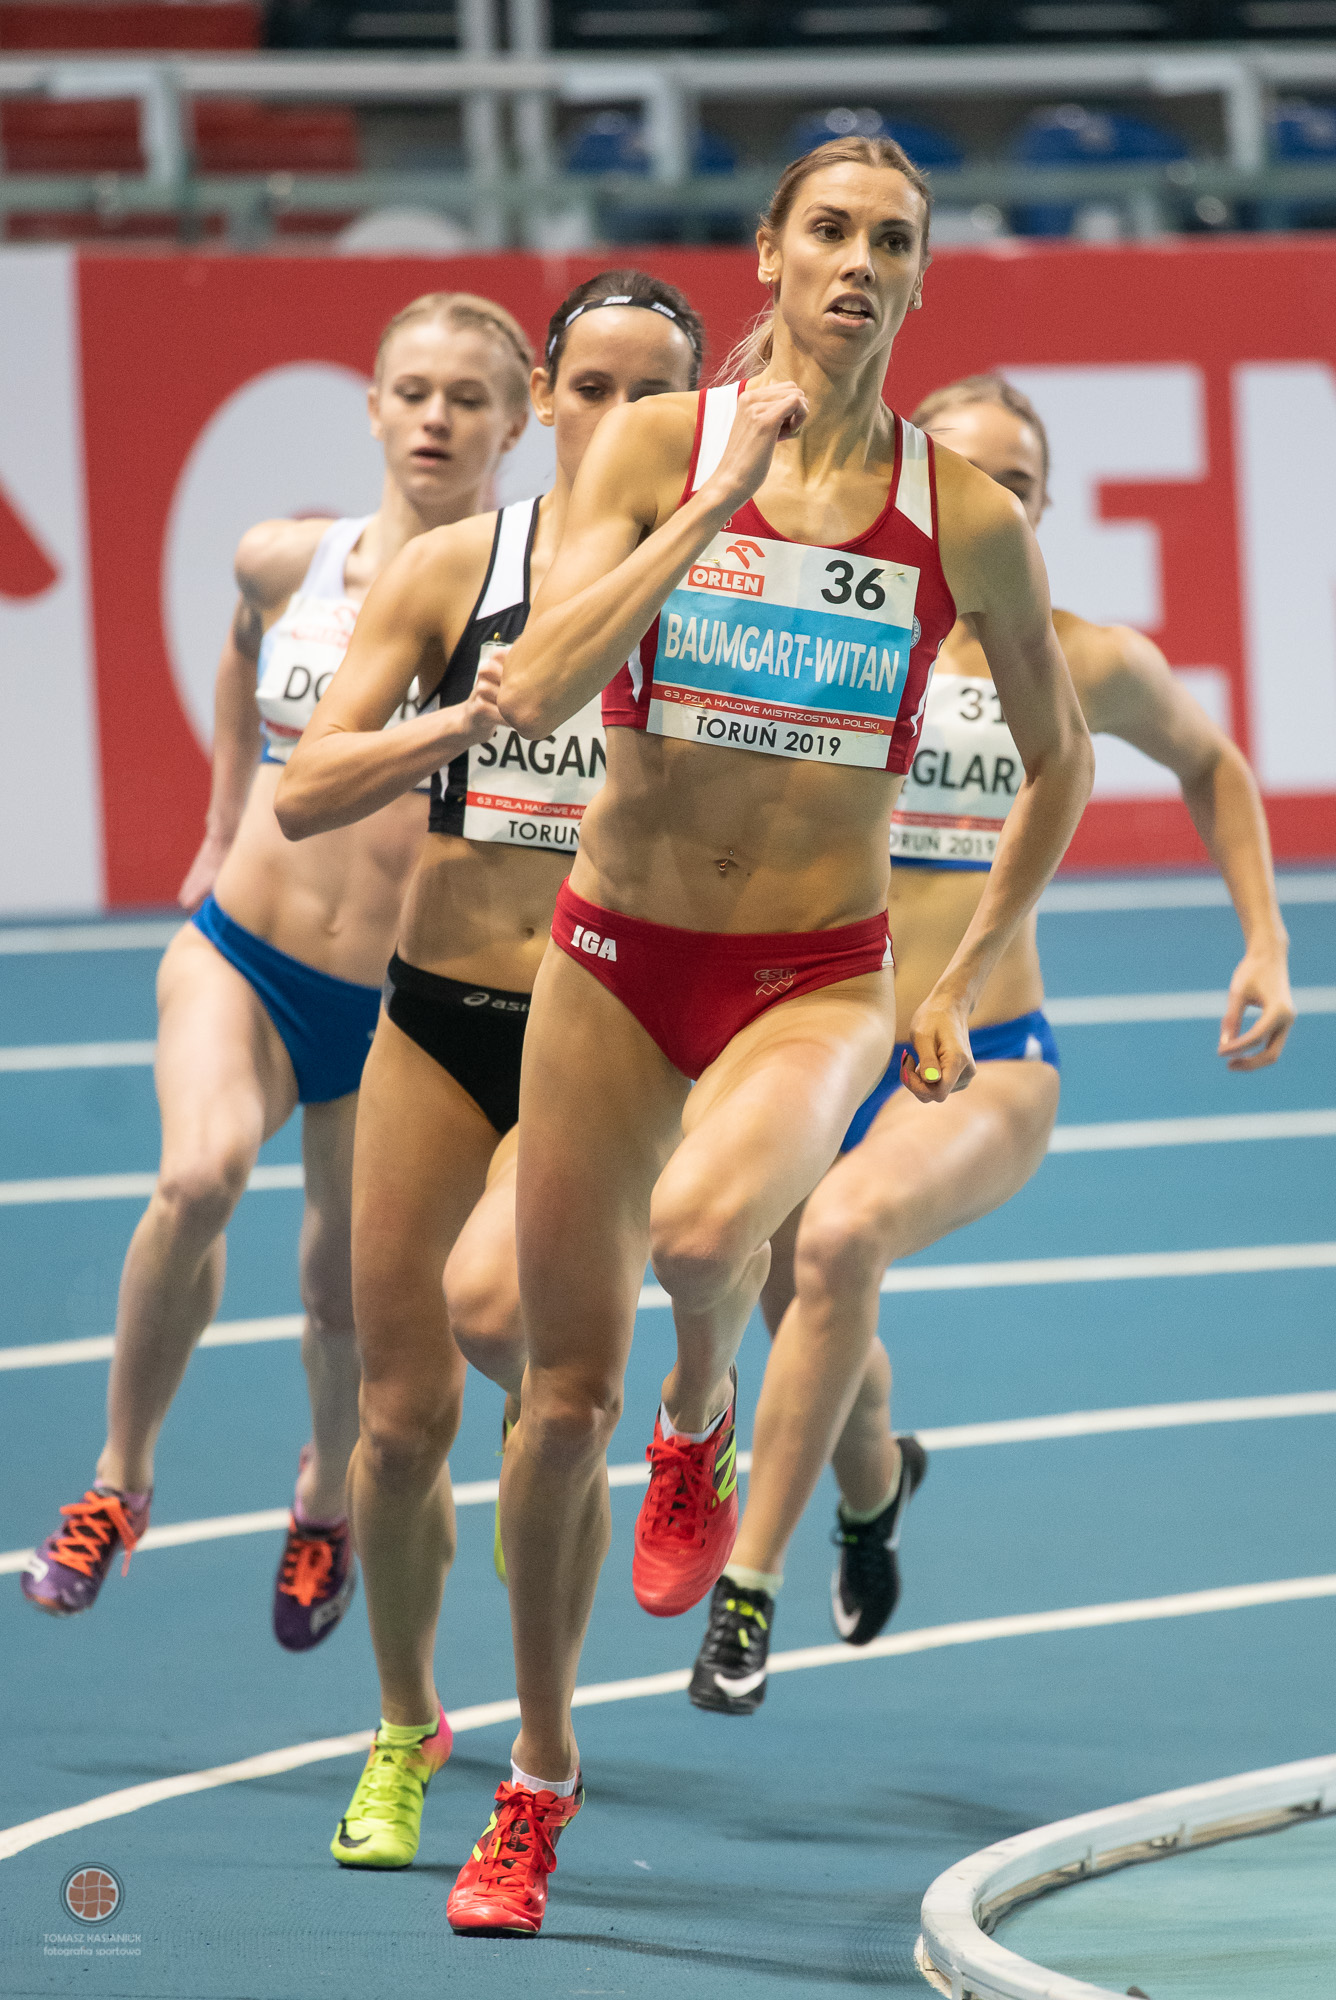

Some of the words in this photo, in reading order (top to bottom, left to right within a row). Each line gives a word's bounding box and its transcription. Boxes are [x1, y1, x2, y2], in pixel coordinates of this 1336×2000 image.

[692, 568, 761, 594] ORLEN
[820, 559, 886, 611] 36
[664, 613, 900, 694] BAUMGART-WITAN
[664, 690, 682, 700] 63.
[683, 693, 712, 706] PZLA
[714, 700, 760, 714] HALOWE
[762, 707, 841, 726] MISTRZOSTWA
[842, 718, 880, 730] POLSKI
[696, 715, 777, 748] TORUŃ
[784, 731, 842, 757] 2019
[902, 750, 1018, 795] GLAR
[570, 924, 617, 962] IGA
[491, 999, 529, 1012] asi
